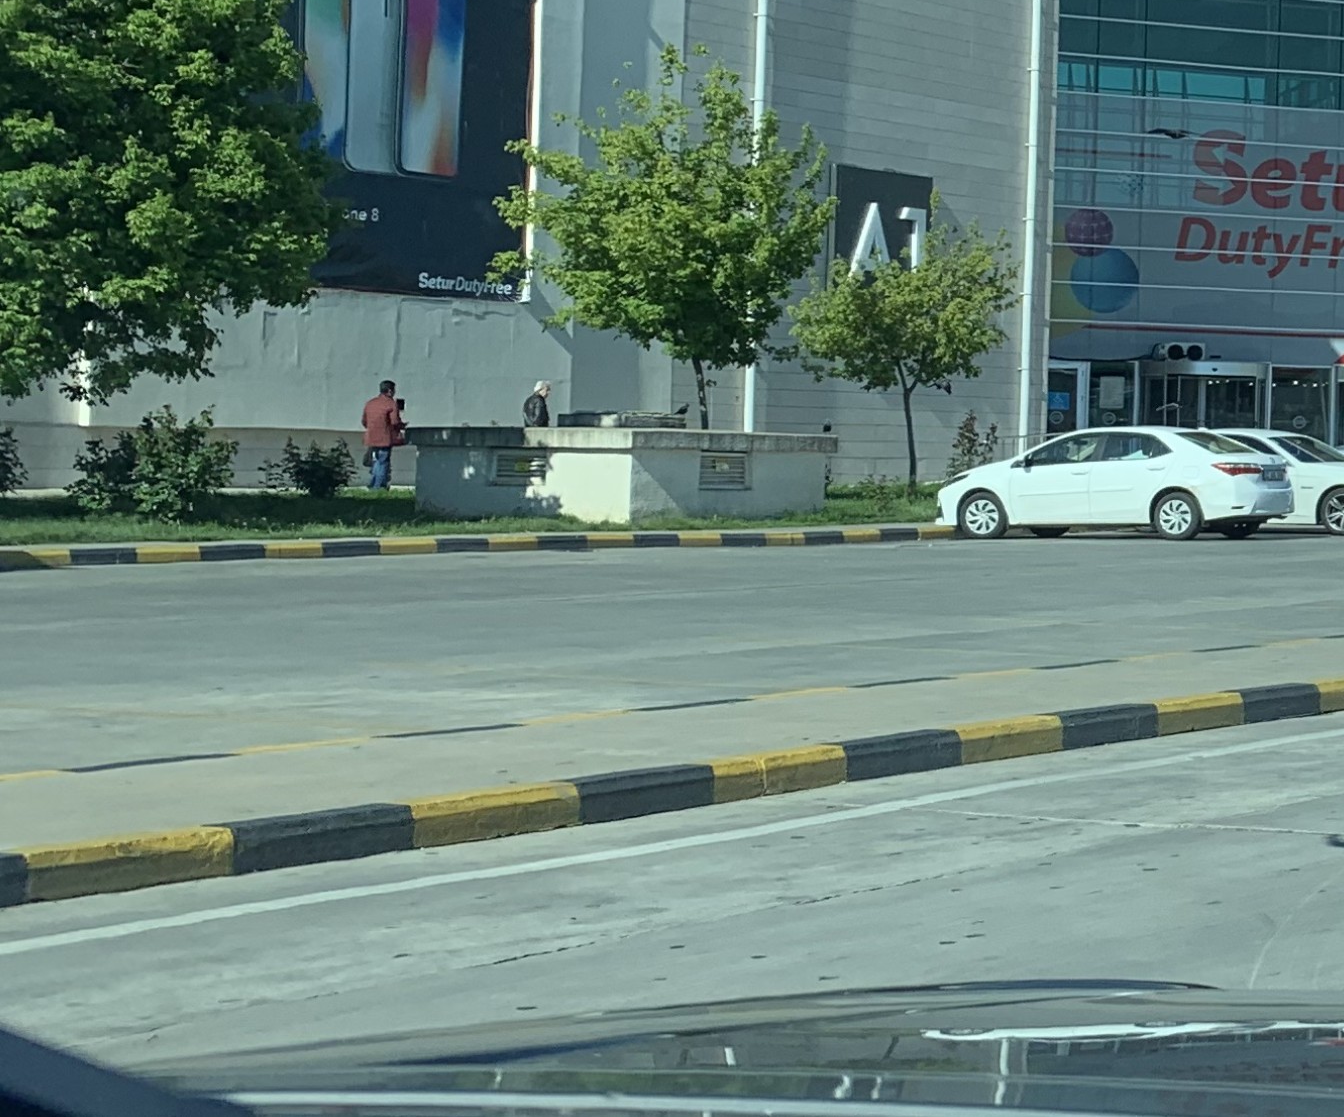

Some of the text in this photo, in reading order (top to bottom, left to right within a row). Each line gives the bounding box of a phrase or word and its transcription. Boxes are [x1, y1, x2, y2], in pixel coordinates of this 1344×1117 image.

[341, 207, 379, 222] one 8
[847, 201, 927, 278] A1
